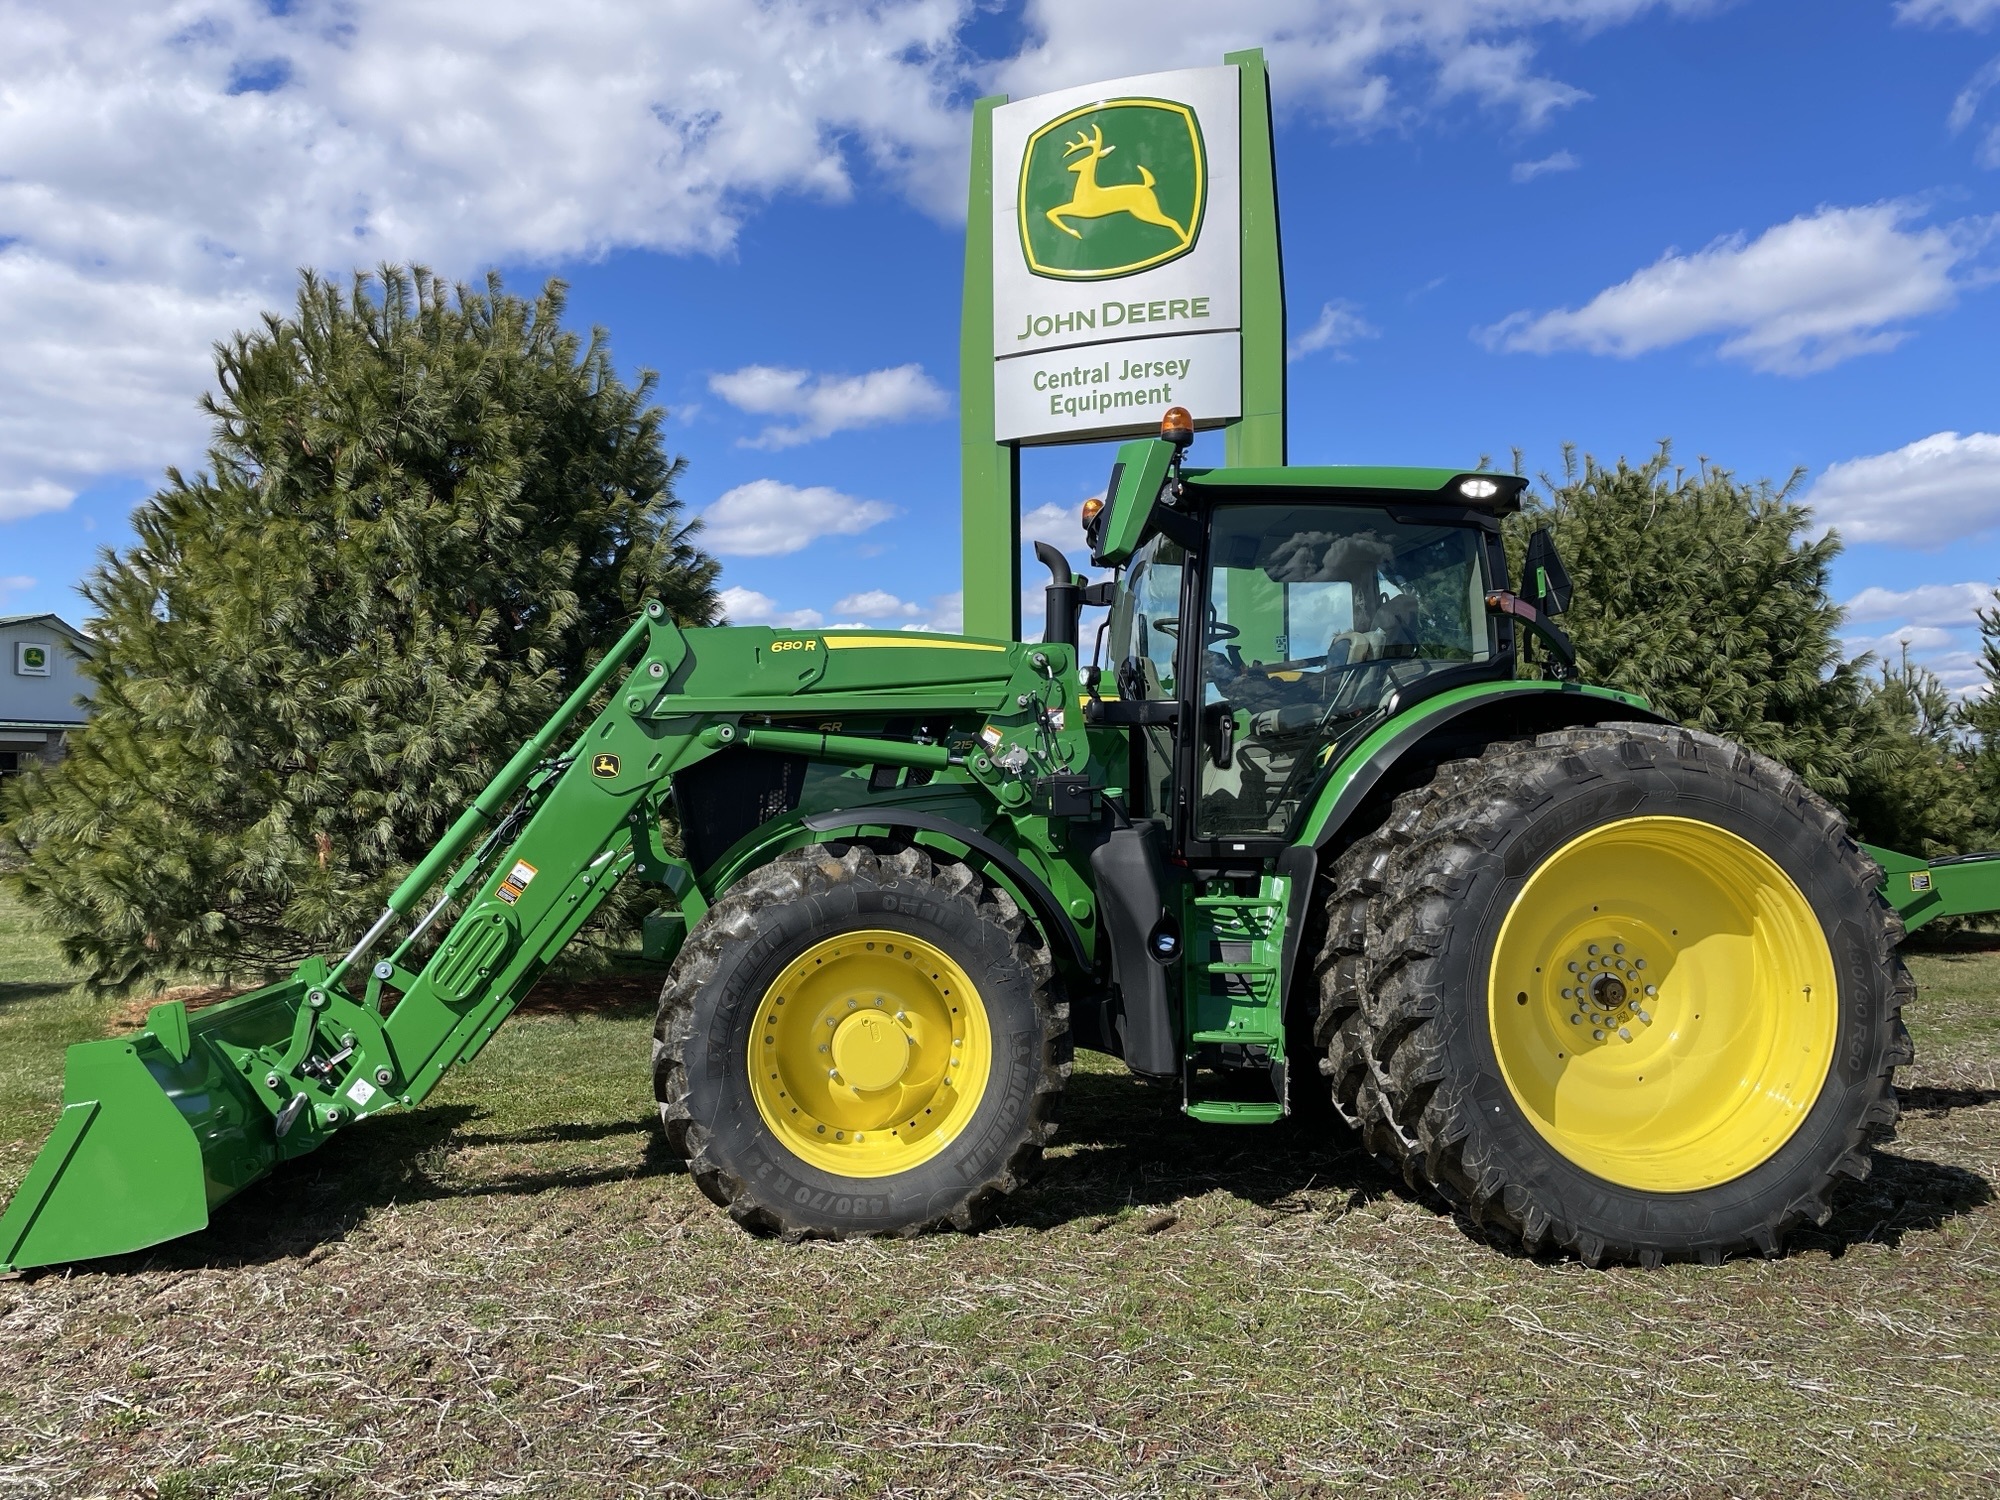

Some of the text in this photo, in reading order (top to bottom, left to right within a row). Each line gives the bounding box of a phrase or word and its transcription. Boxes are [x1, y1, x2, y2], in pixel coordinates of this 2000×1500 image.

[1017, 297, 1210, 340] JOHN DEERE
[1033, 358, 1191, 391] Central Jersey
[1050, 383, 1172, 417] Equipment
[771, 640, 817, 653] 680 R
[951, 740, 974, 750] 215
[1522, 798, 1596, 860] AGRIBIB
[709, 926, 784, 1045] MICHELIN
[962, 1062, 1029, 1181] MICHELIN
[794, 1186, 884, 1216] 480/70
